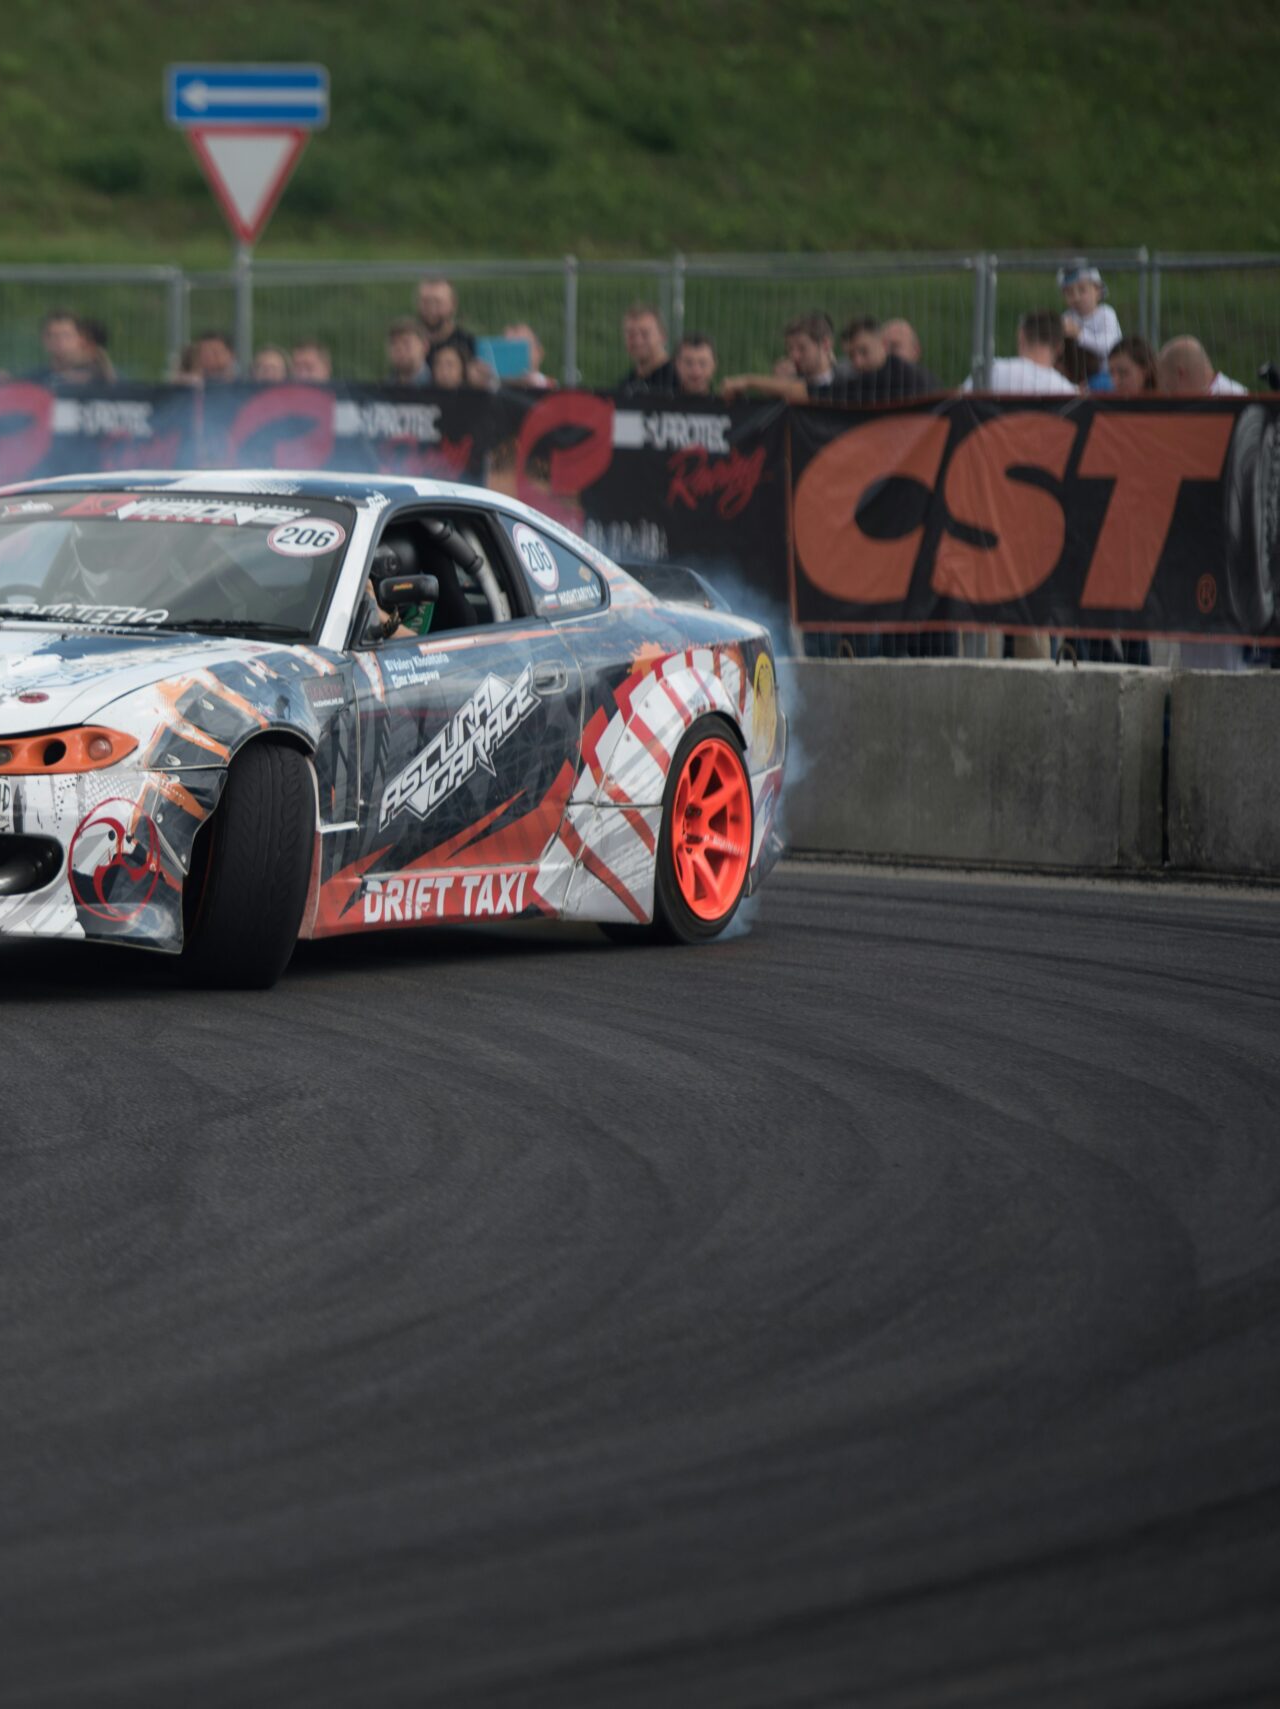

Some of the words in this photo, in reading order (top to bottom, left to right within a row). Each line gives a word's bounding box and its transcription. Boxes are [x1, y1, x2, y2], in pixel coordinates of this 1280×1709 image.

[276, 526, 335, 548] 206
[520, 541, 552, 572] 206
[793, 410, 1234, 610] CST
[380, 672, 515, 832] ASCURA
[406, 662, 542, 820] GARAGE
[363, 875, 455, 923] DRIFT
[460, 871, 528, 917] TAXI
